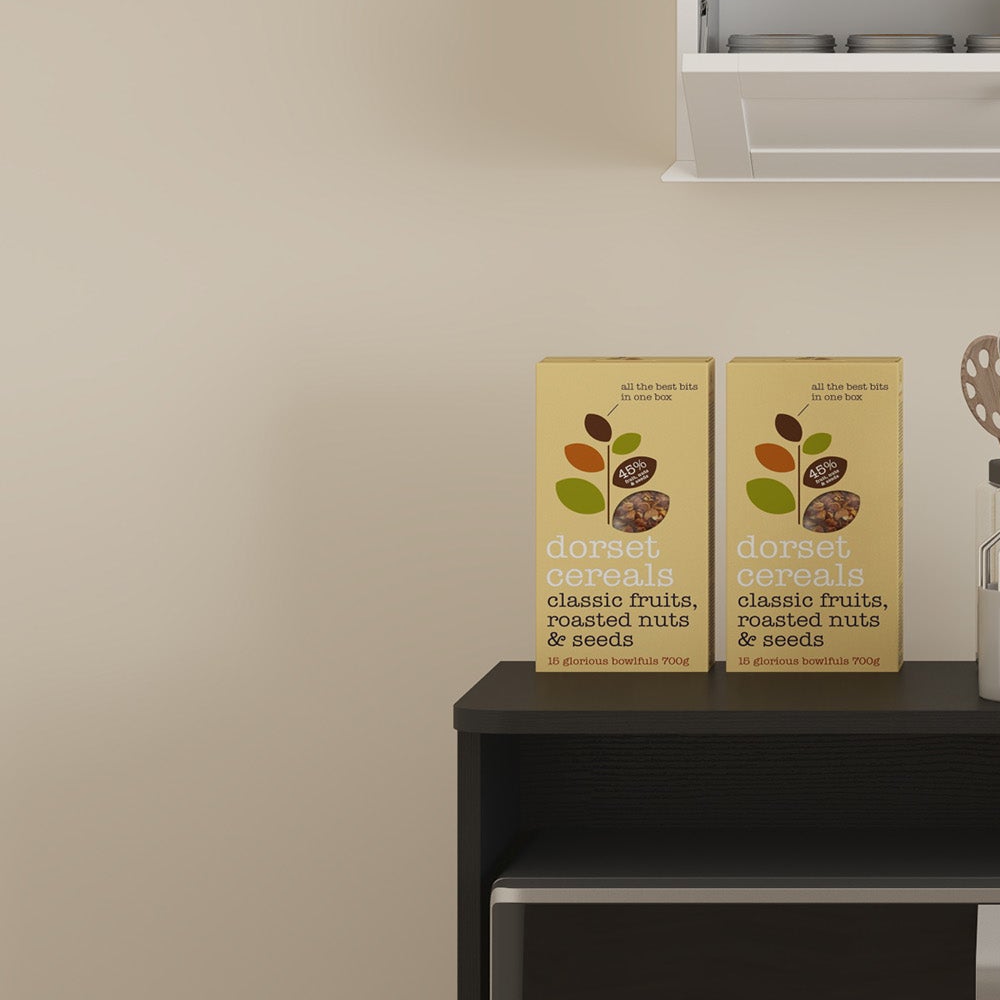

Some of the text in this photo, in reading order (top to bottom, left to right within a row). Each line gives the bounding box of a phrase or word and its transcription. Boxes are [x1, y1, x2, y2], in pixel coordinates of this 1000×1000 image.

[621, 382, 698, 391] all the best bits
[811, 382, 889, 391] all the best bits
[621, 393, 631, 401] in
[655, 393, 672, 401] box
[811, 393, 821, 401] in
[845, 393, 863, 401] box
[618, 460, 647, 479] 45%
[809, 460, 838, 479] 45%
[546, 535, 660, 559] dorset
[736, 535, 851, 559] dorset
[546, 563, 674, 588] cereals
[736, 563, 865, 588] cereals
[547, 592, 698, 611] classic fruits,
[737, 592, 888, 611] classic fruits,
[547, 612, 690, 628] roasted nuts
[737, 612, 881, 628] roasted nuts
[547, 631, 634, 647] & seeds
[737, 631, 824, 647] & seeds
[548, 656, 690, 667] 15 glorious bowlfuls 700g
[738, 656, 880, 667] 15 glorious bowlfuls 700g
